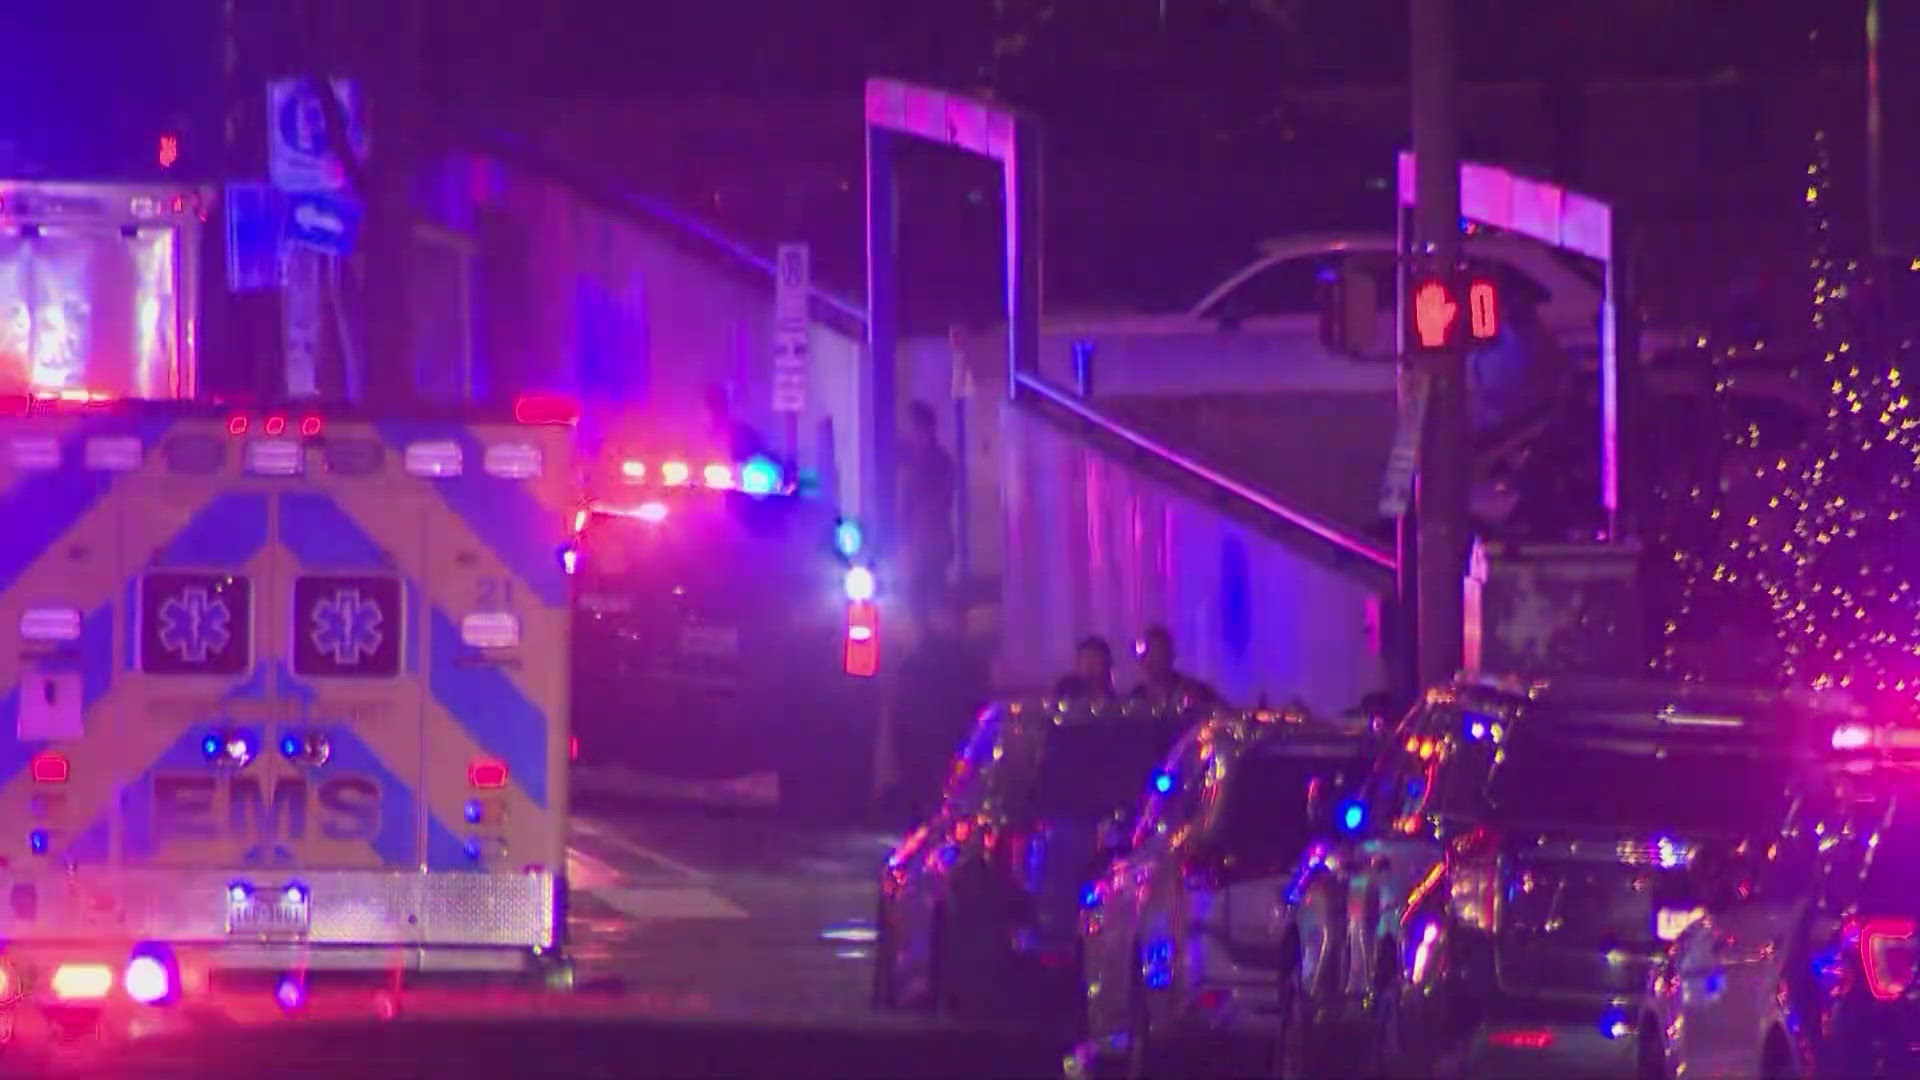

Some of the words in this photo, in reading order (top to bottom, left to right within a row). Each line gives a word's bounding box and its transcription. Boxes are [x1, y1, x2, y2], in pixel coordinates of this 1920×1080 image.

[1470, 283, 1496, 338] 0
[476, 577, 513, 613] 21
[154, 777, 381, 840] EMS
